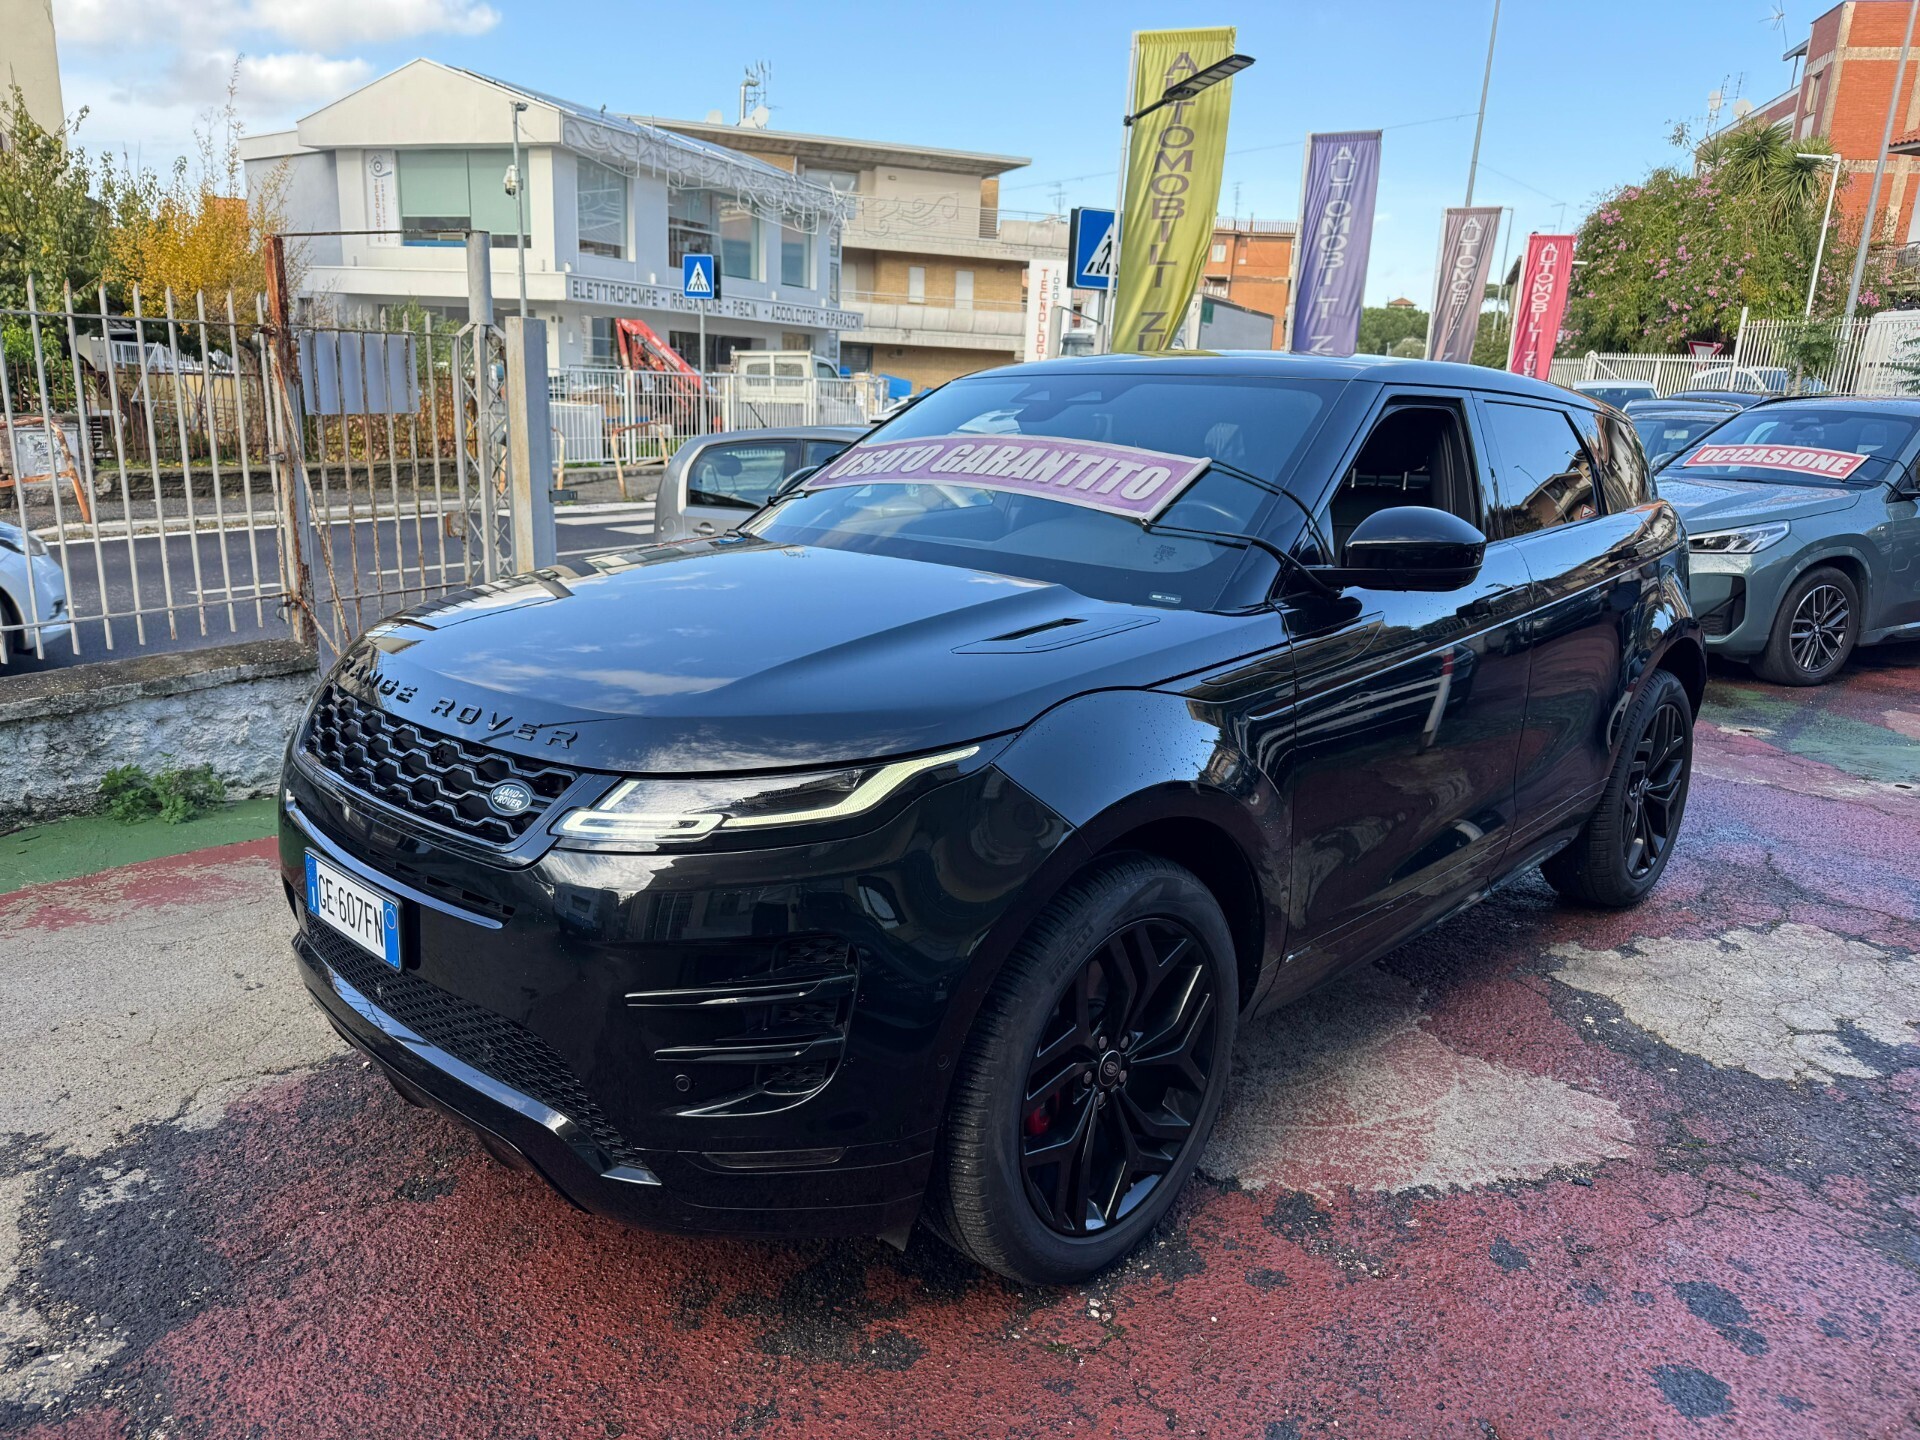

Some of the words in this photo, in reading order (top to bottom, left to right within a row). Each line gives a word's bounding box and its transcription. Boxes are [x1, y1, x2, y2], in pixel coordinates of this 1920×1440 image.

[572, 280, 658, 306] ELETTROPOMPE
[1529, 243, 1557, 342] AUTOMOBILI
[828, 444, 935, 480] USATO
[930, 443, 1172, 501] GARANTITO
[1696, 448, 1854, 474] OCCASIONE
[340, 655, 418, 704] RANGE
[431, 697, 579, 750] ROVER
[496, 795, 523, 809] ROVER
[498, 787, 521, 798] LAND
